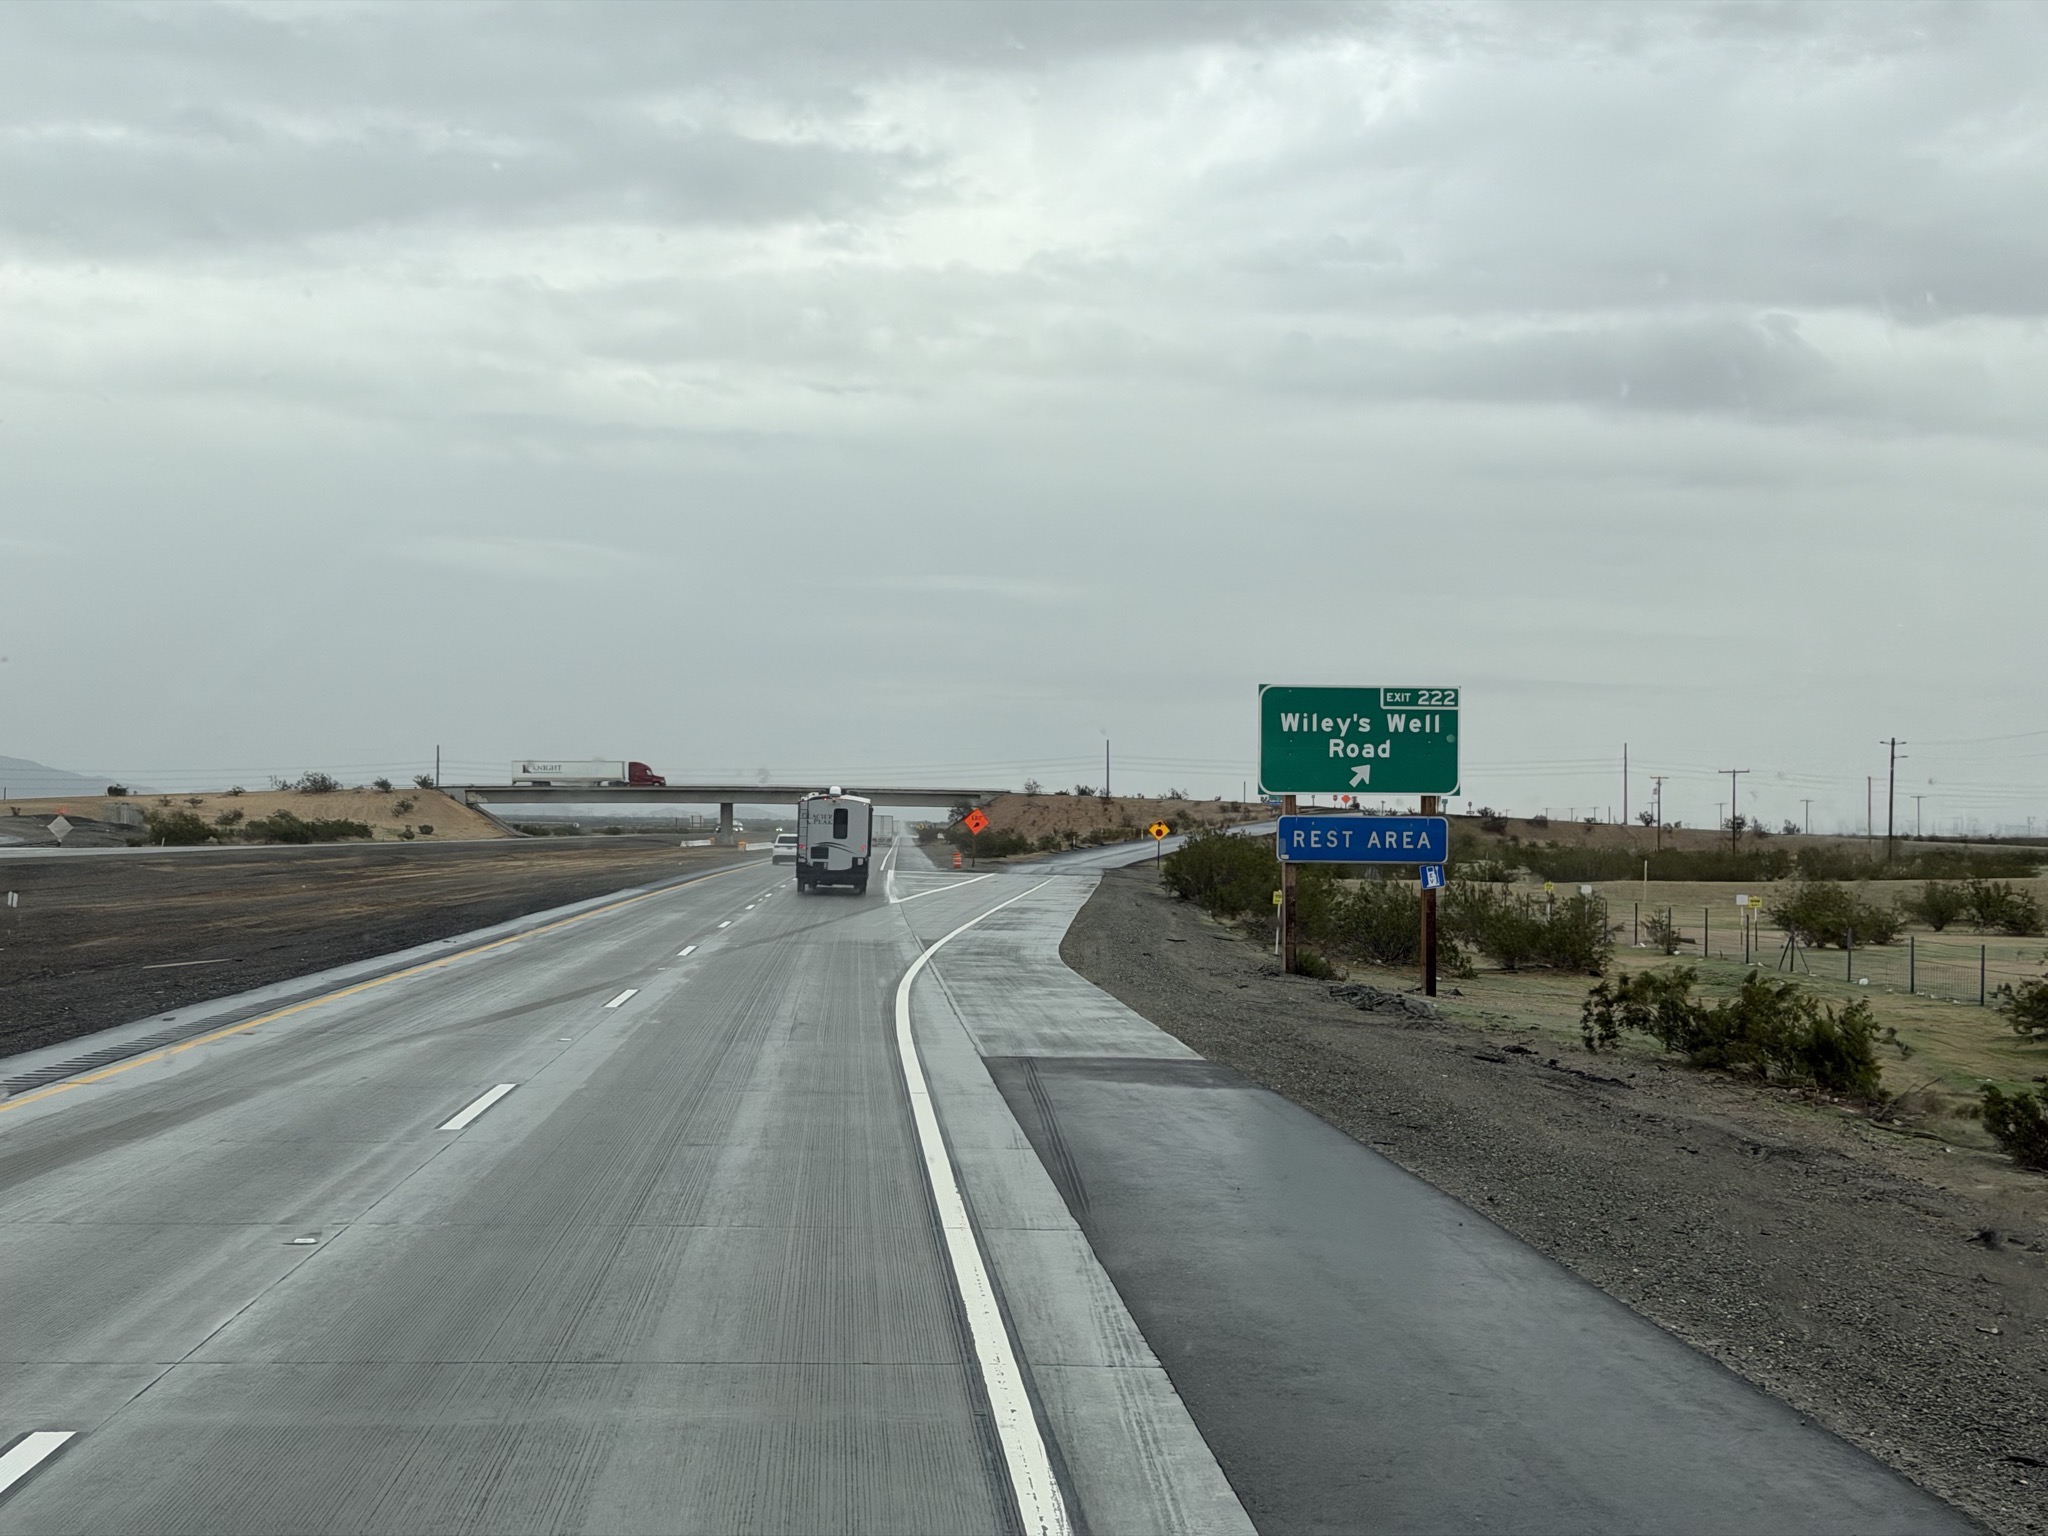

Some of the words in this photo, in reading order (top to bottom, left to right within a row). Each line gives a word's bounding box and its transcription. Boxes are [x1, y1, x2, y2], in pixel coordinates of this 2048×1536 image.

[1386, 692, 1411, 702] EXIT
[1417, 690, 1455, 705] 222
[1280, 713, 1371, 737] Wiley's
[1386, 714, 1440, 733] Well
[1329, 739, 1391, 758] Road
[1293, 830, 1353, 848] REST
[1367, 832, 1431, 849] AREA
